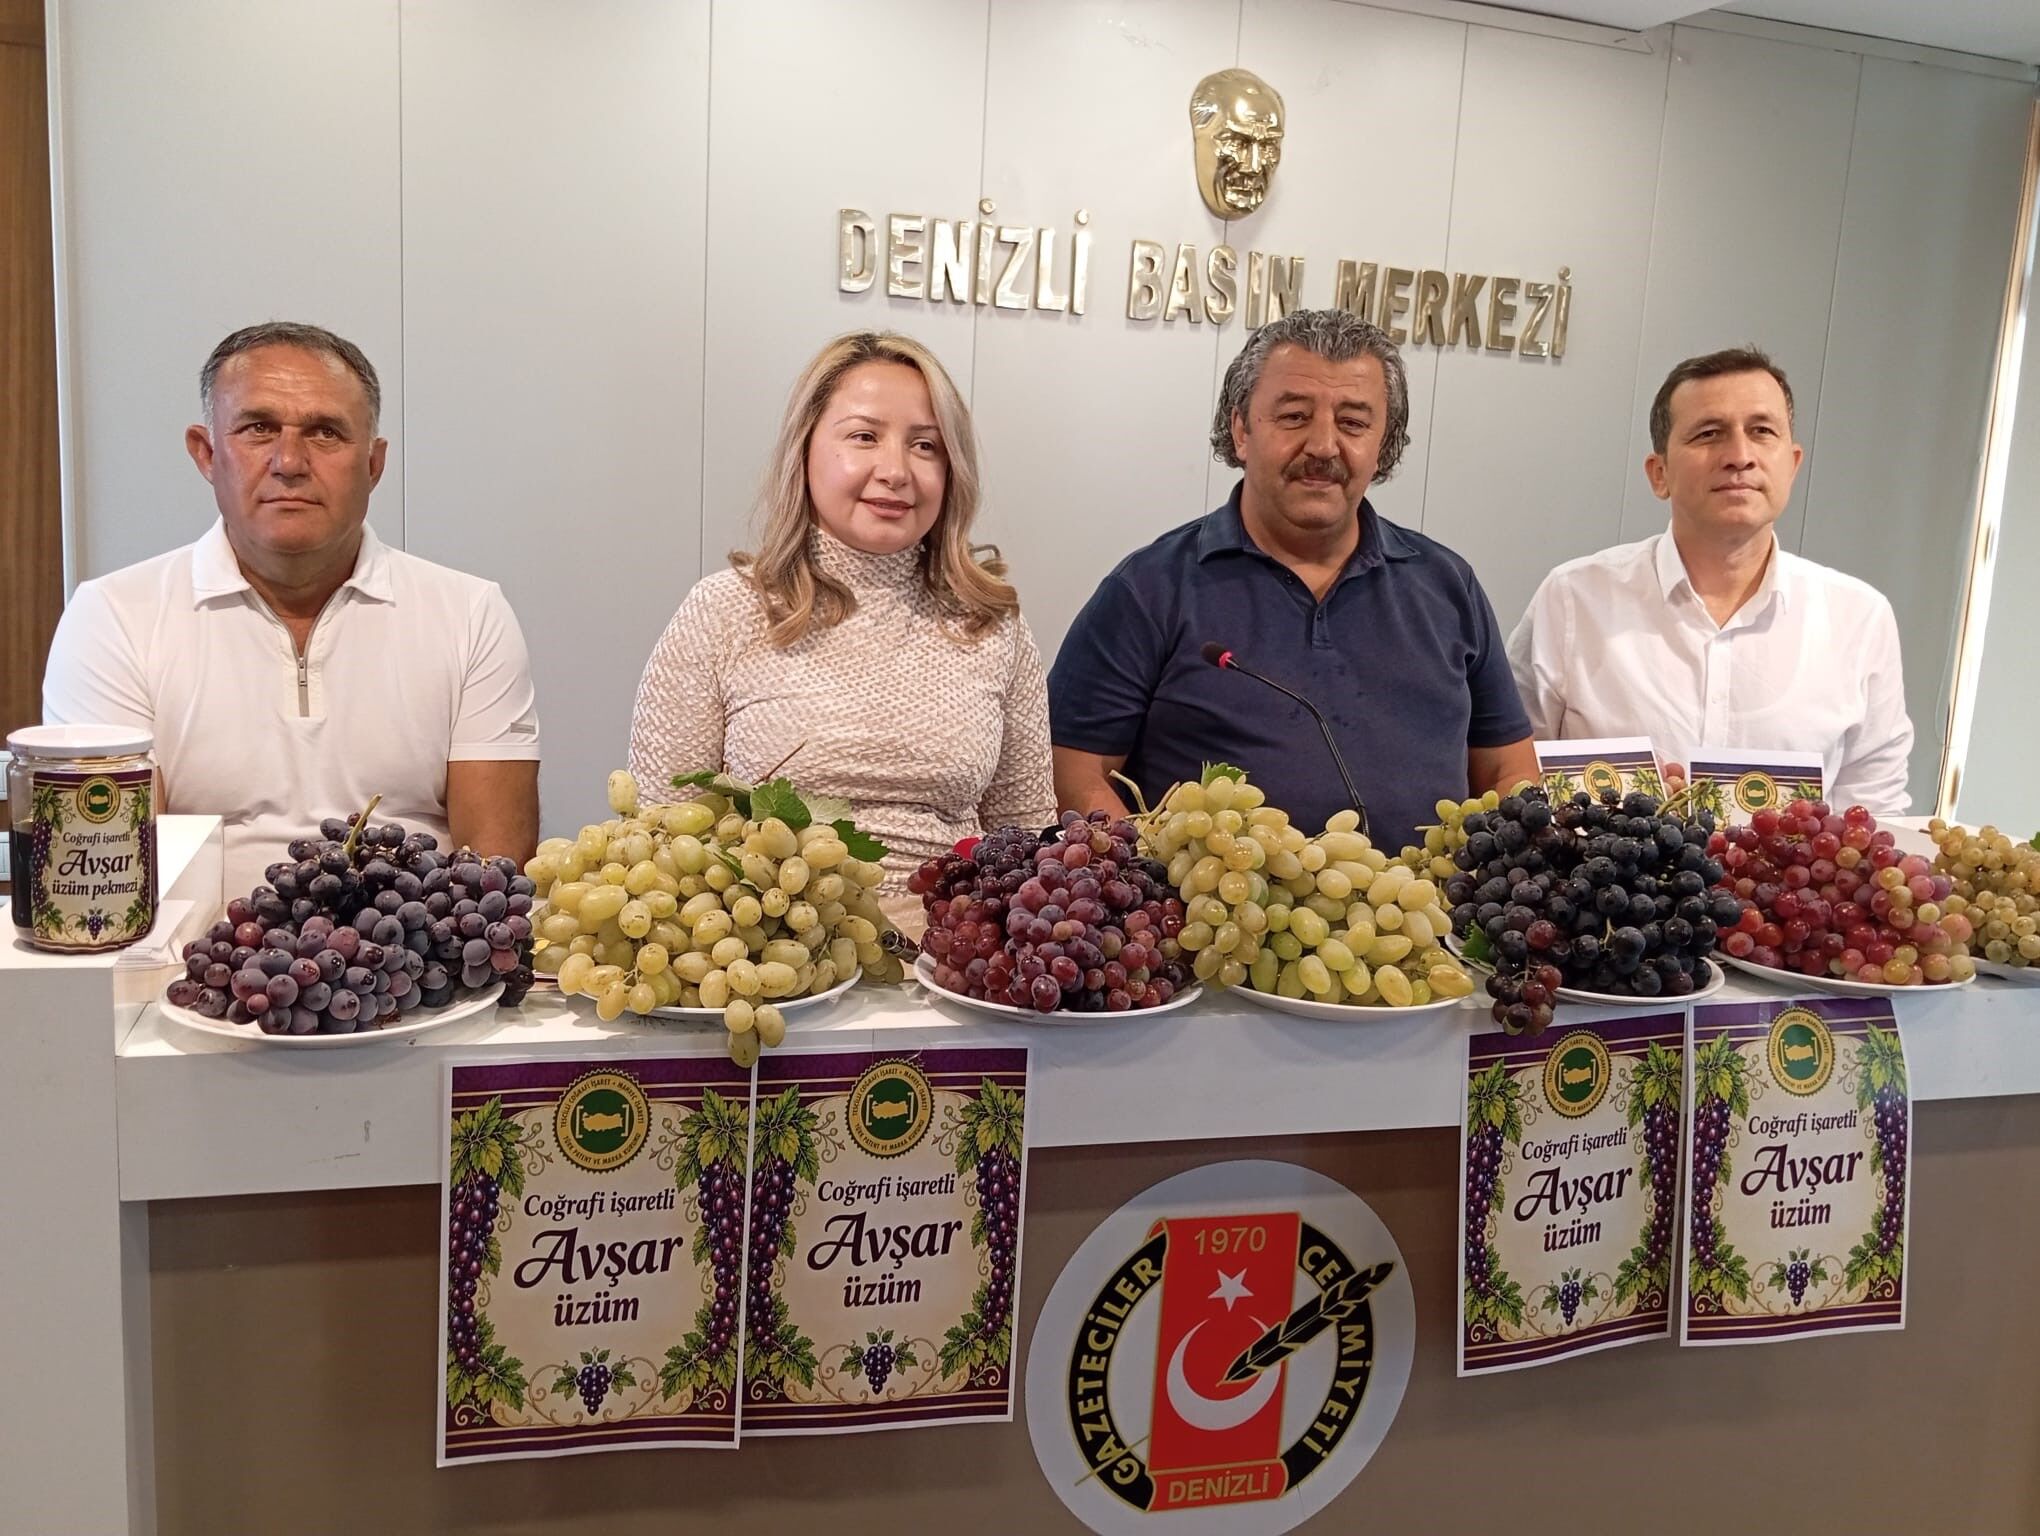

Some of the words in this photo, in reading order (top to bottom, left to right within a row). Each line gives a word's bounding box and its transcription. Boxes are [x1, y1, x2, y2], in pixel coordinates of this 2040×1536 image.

[839, 198, 1090, 316] DENİZLİ
[1128, 239, 1304, 330] BASIN
[1336, 258, 1572, 358] MERKEZİ
[63, 832, 101, 846] Coğrafi
[103, 831, 130, 845] işaretli
[58, 849, 134, 879] Avşar
[52, 881, 89, 896] üzüm
[92, 878, 138, 900] pekmezi
[1748, 1116, 1808, 1138] Coğrafi
[1811, 1110, 1858, 1135] işaretli
[1521, 1137, 1579, 1161] Coğrafi
[1581, 1127, 1627, 1154] işaretli
[1740, 1144, 1864, 1196] Avşar
[523, 1192, 605, 1222] Coğrafi
[610, 1189, 675, 1218] işaretli
[817, 1177, 891, 1206] Coğrafi
[896, 1174, 956, 1202] işaretli
[1514, 1166, 1633, 1221] Avşar
[1770, 1200, 1831, 1229] üzüm
[807, 1211, 963, 1271] Avşar
[1193, 1226, 1267, 1256] 1970
[1543, 1219, 1601, 1253] üzüm
[513, 1227, 684, 1288] Avşar
[842, 1273, 921, 1308] üzüm
[553, 1292, 639, 1327] üzüm
[1076, 1256, 1163, 1486] GAZETECİLER
[1168, 1466, 1271, 1504] DENİZLİ
